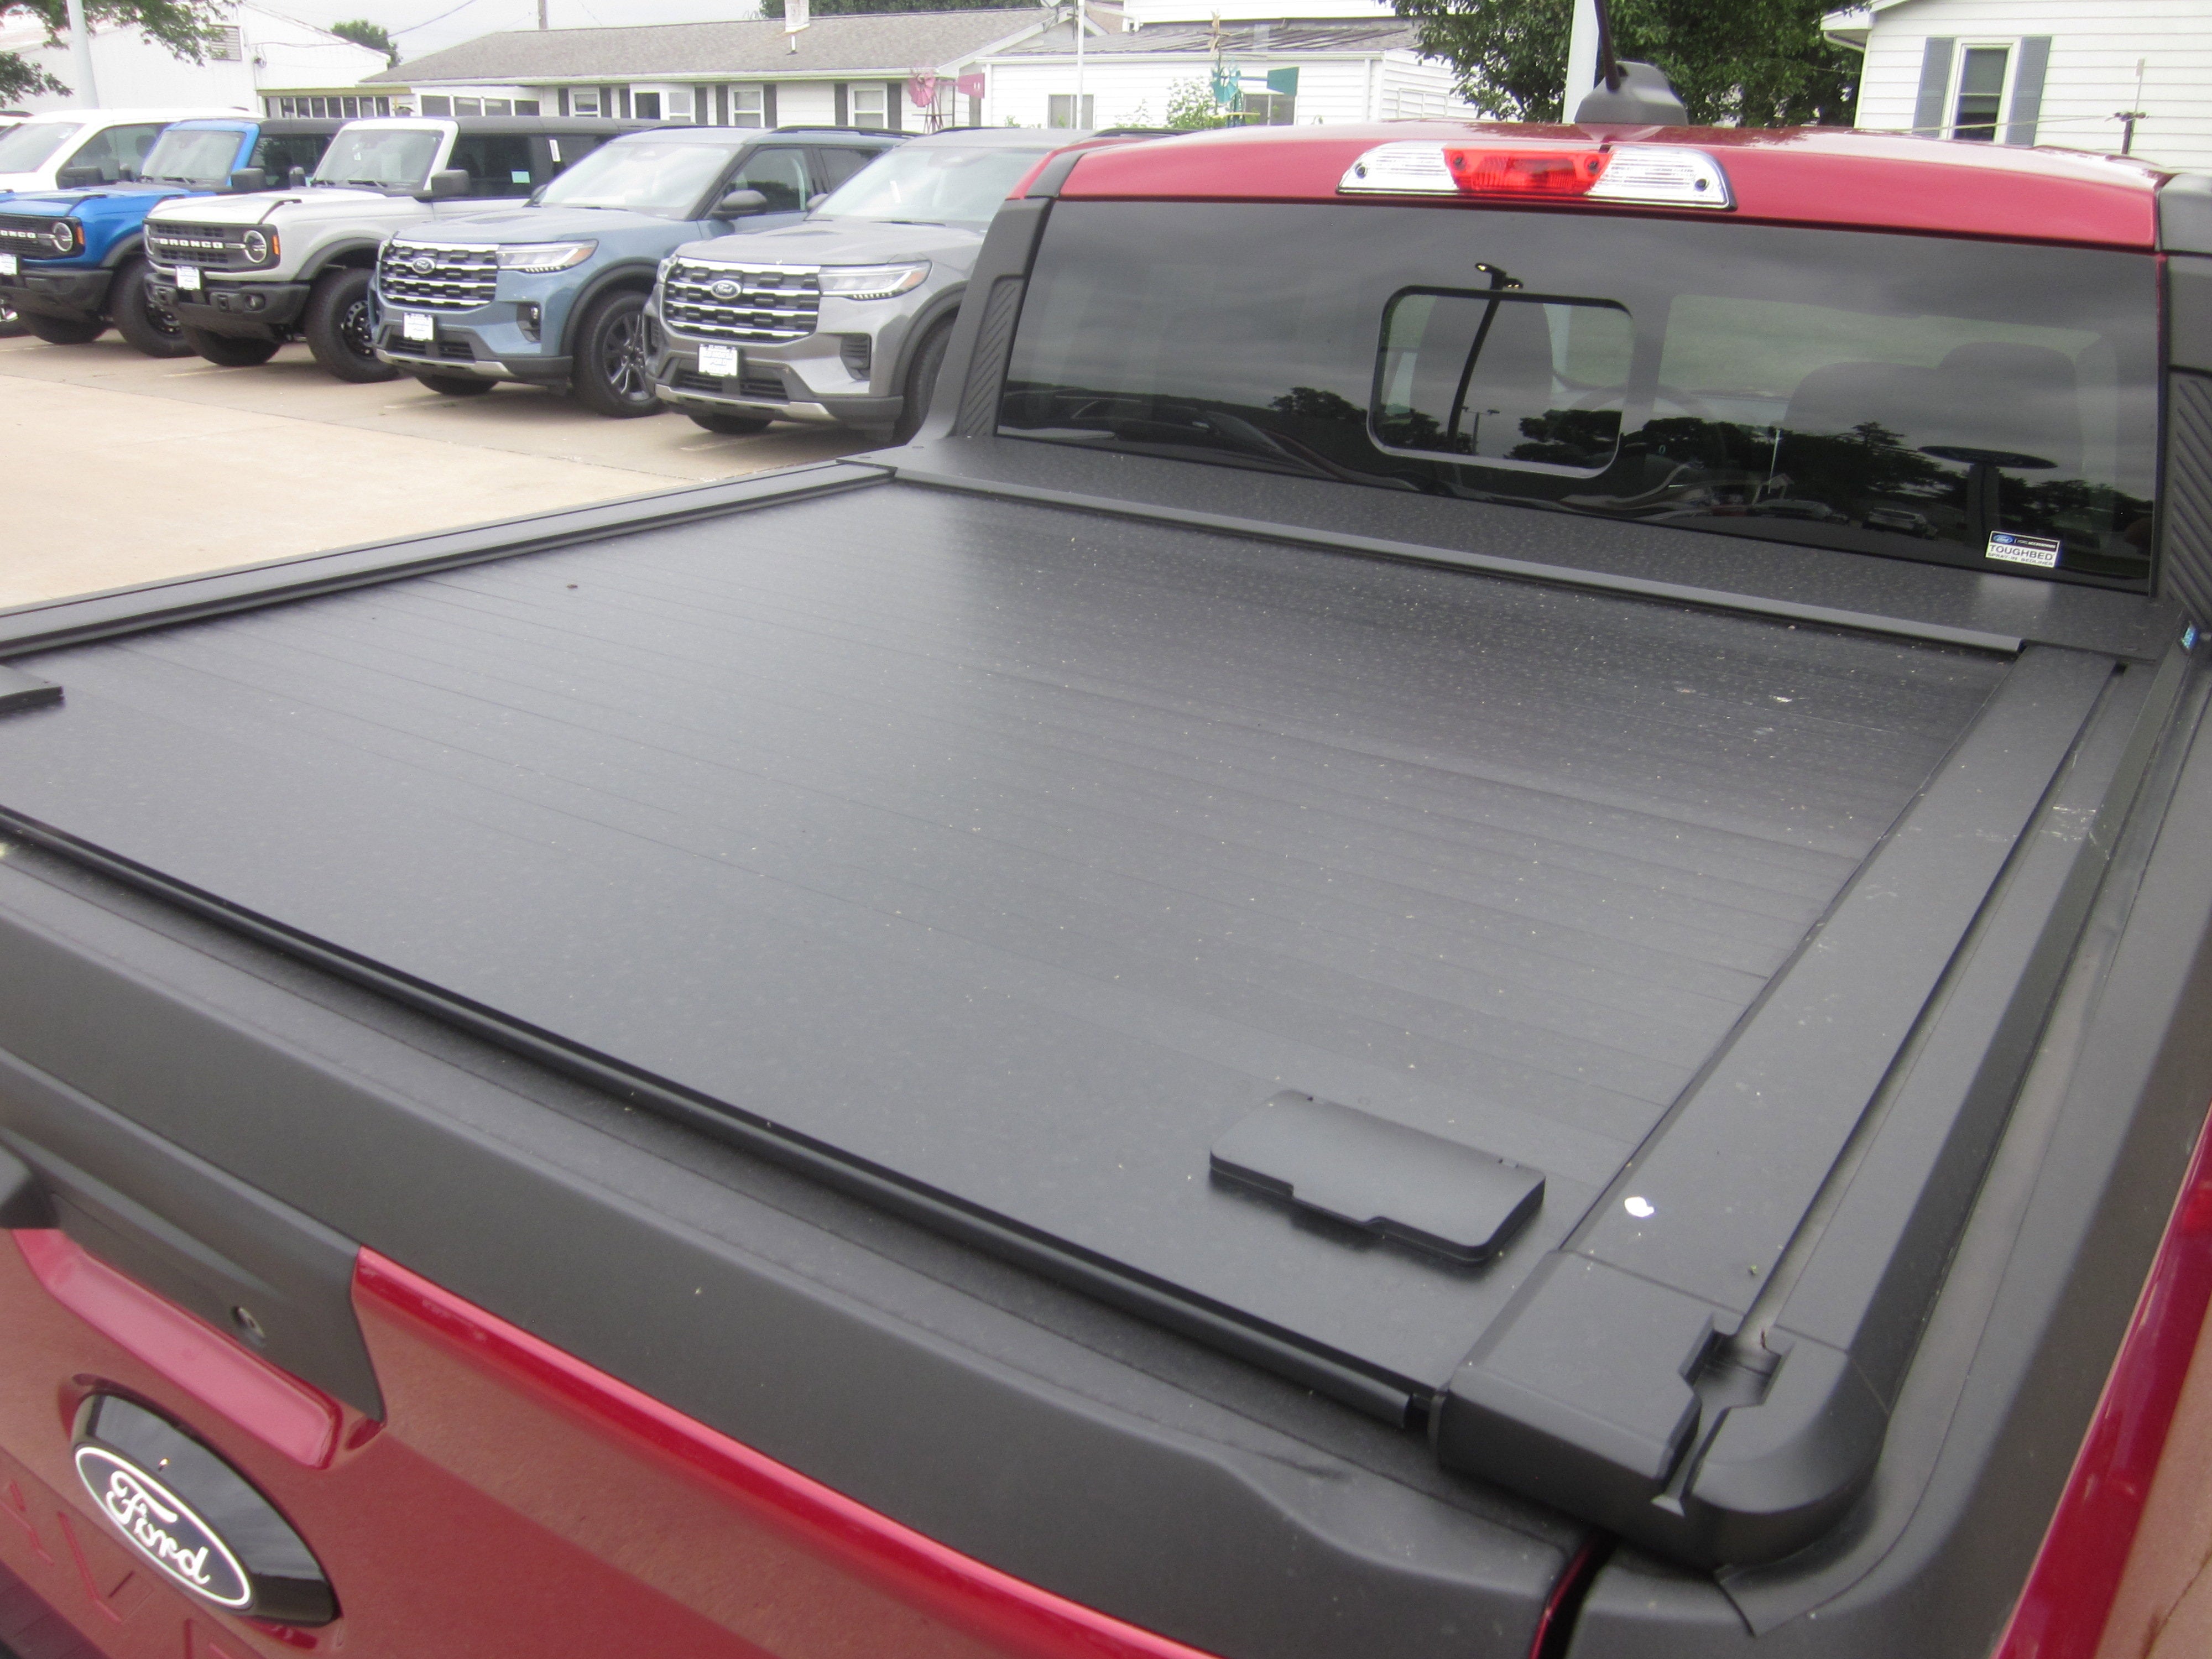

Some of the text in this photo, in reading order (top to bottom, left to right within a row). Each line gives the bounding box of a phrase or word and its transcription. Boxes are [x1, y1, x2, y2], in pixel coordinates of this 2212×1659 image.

[159, 237, 224, 249] BRONCO
[715, 283, 733, 294] Ford
[1990, 545, 2053, 561] TOUGHBED
[2021, 557, 2053, 566] BEDLINER
[105, 1469, 211, 1585] Ford
